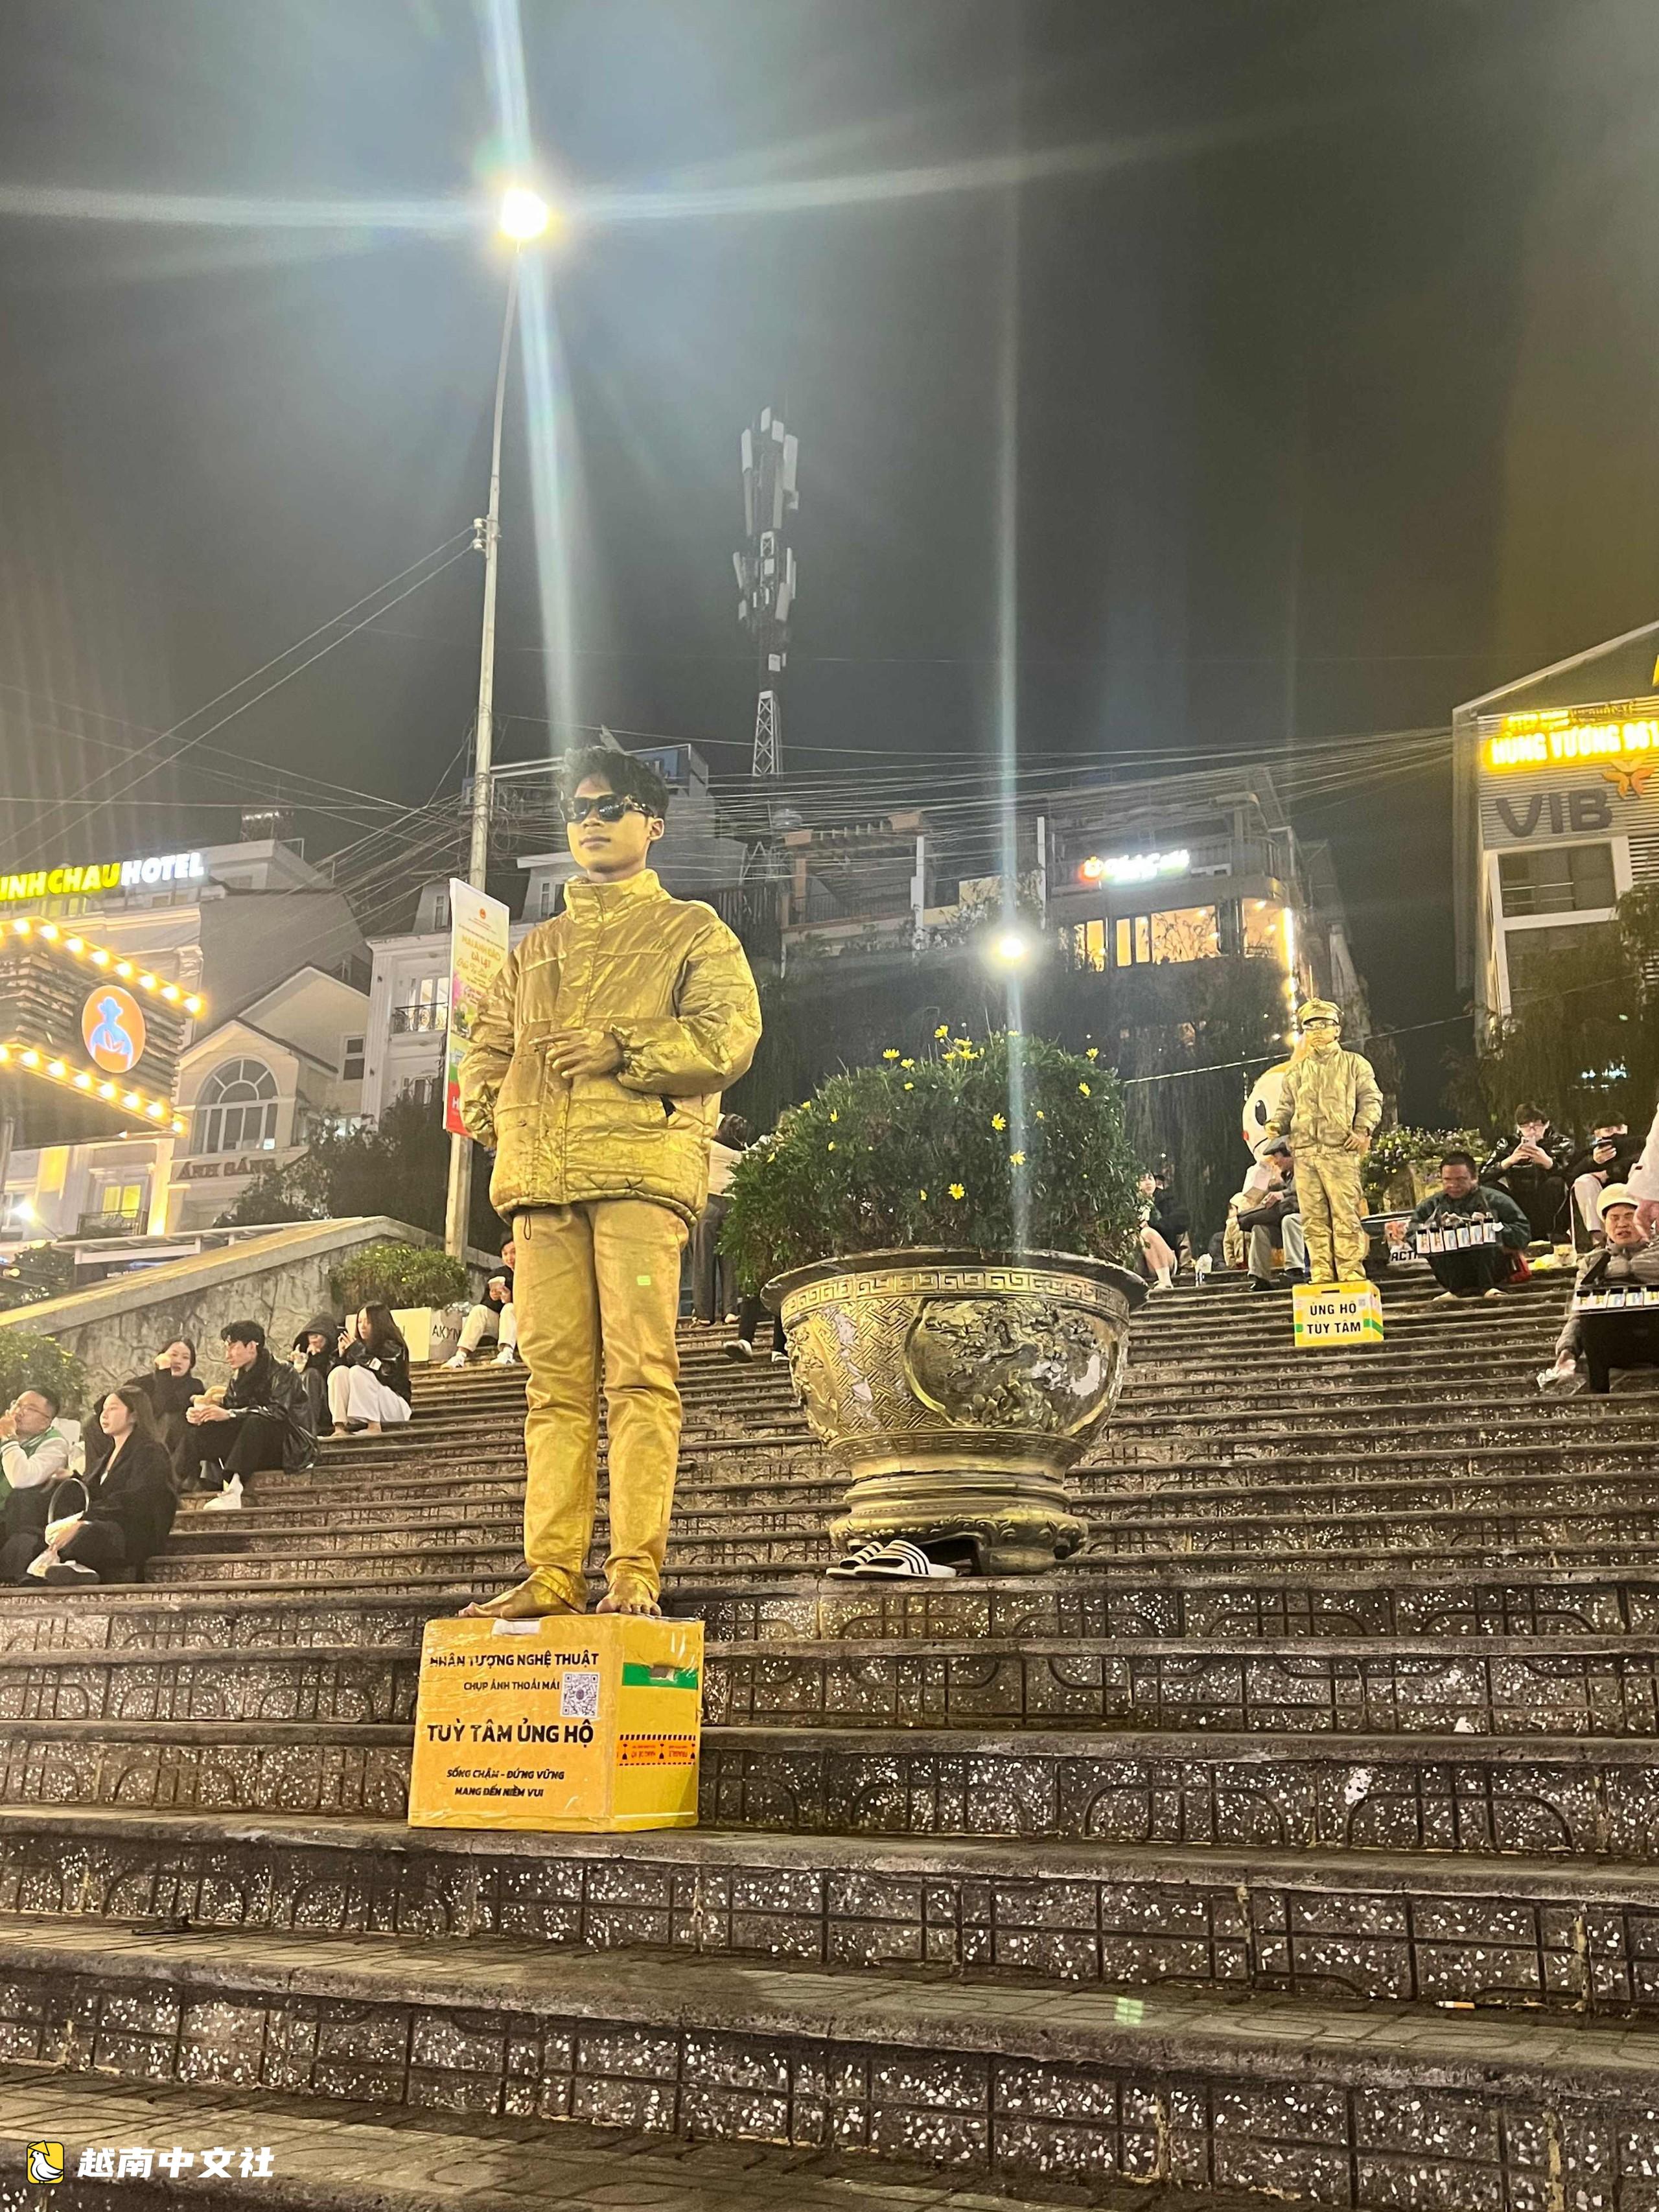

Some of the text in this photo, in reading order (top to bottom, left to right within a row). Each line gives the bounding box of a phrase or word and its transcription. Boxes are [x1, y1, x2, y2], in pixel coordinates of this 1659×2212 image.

[1496, 788, 1613, 837] VIB
[121, 852, 203, 887] HOTEL
[517, 1650, 551, 1669] NGHỆ
[554, 1649, 599, 1668] THUẬT
[464, 1682, 488, 1692] CHỤP
[427, 1717, 594, 1748] TUỲ TÂM ỦNG HỘ
[455, 1787, 481, 1796] MANG
